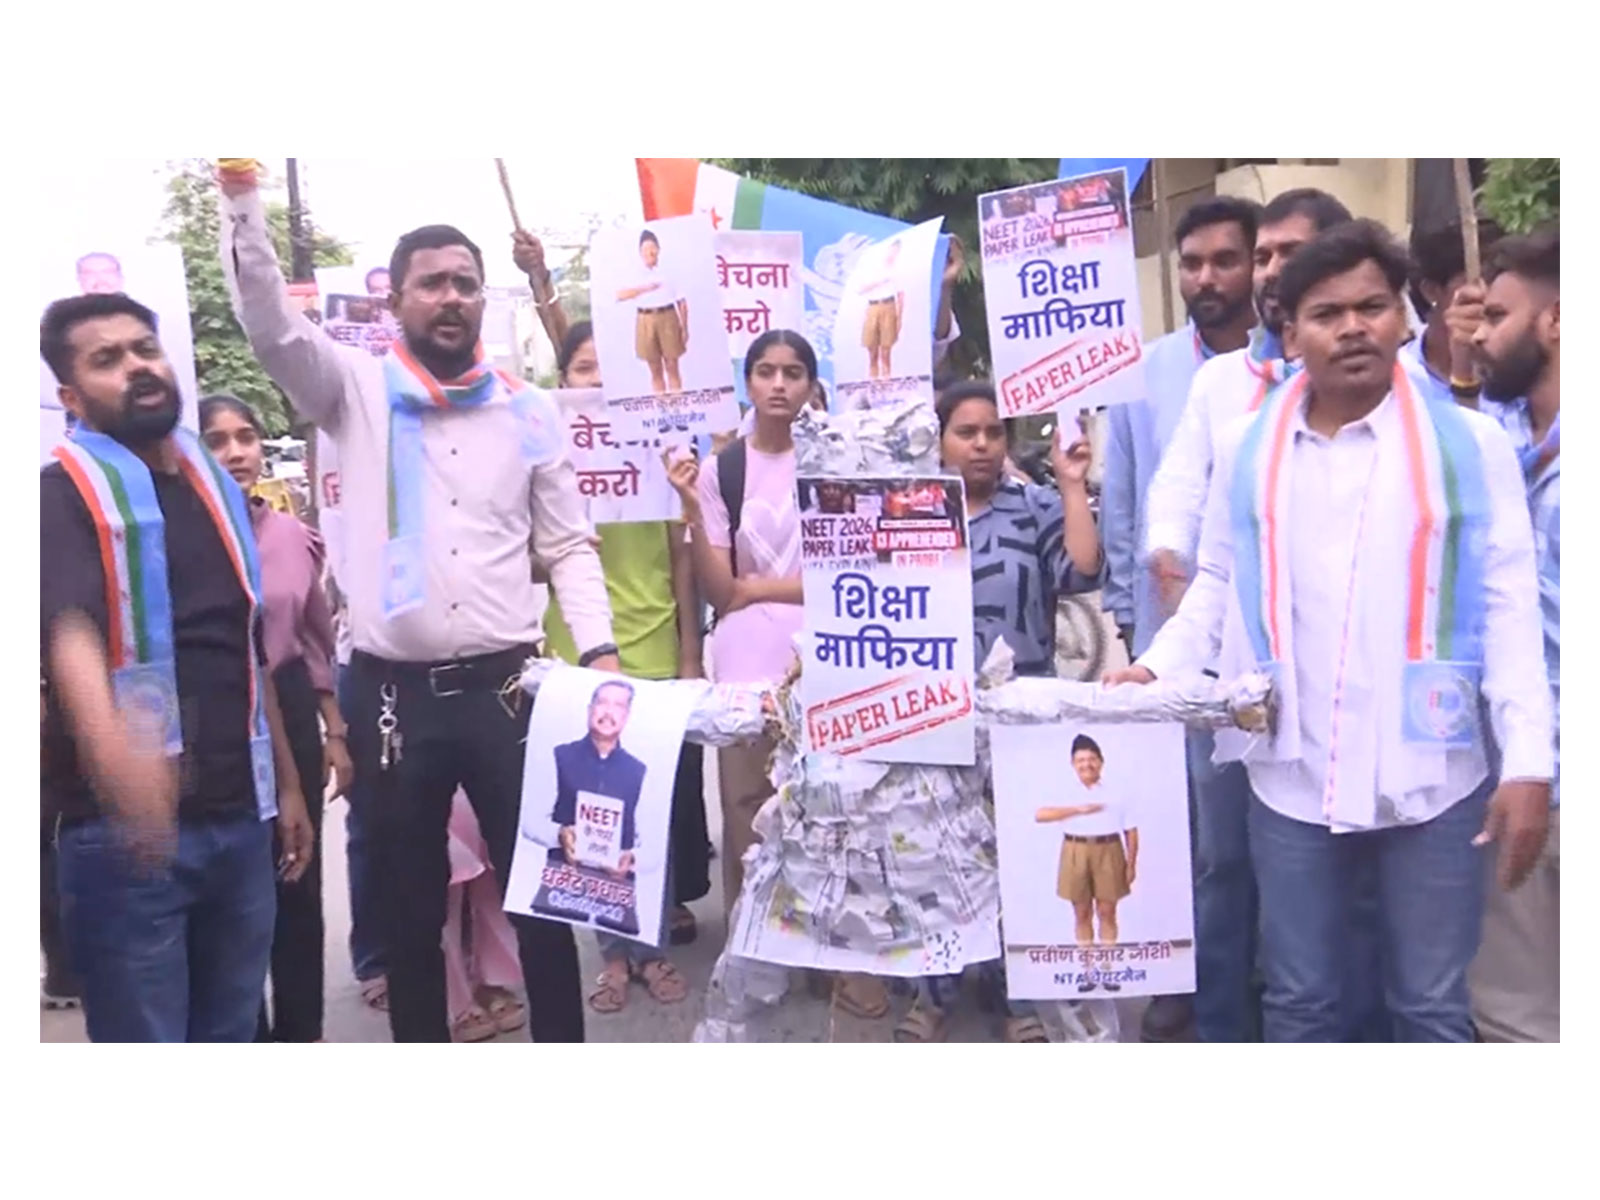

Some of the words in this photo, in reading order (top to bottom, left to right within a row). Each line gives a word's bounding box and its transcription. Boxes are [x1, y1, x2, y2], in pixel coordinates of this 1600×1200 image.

[983, 220, 1018, 242] NEET
[984, 238, 1020, 258] PAPER
[1017, 259, 1101, 298] शिक्षा
[1001, 298, 1125, 339] माफिया
[1010, 361, 1076, 410] PAPER
[1076, 333, 1130, 376] LEAK
[576, 460, 642, 497] करो
[801, 517, 837, 538] NEET
[839, 516, 874, 536] 2026
[802, 539, 836, 559] PAPER
[832, 572, 931, 623] शिक्षा
[815, 624, 958, 670] माफिया
[817, 702, 890, 748] PAPER
[891, 679, 958, 723] LEAK
[580, 803, 621, 827] NEET
[1029, 944, 1074, 965] प्रवीण
[1077, 946, 1125, 968] कुमार
